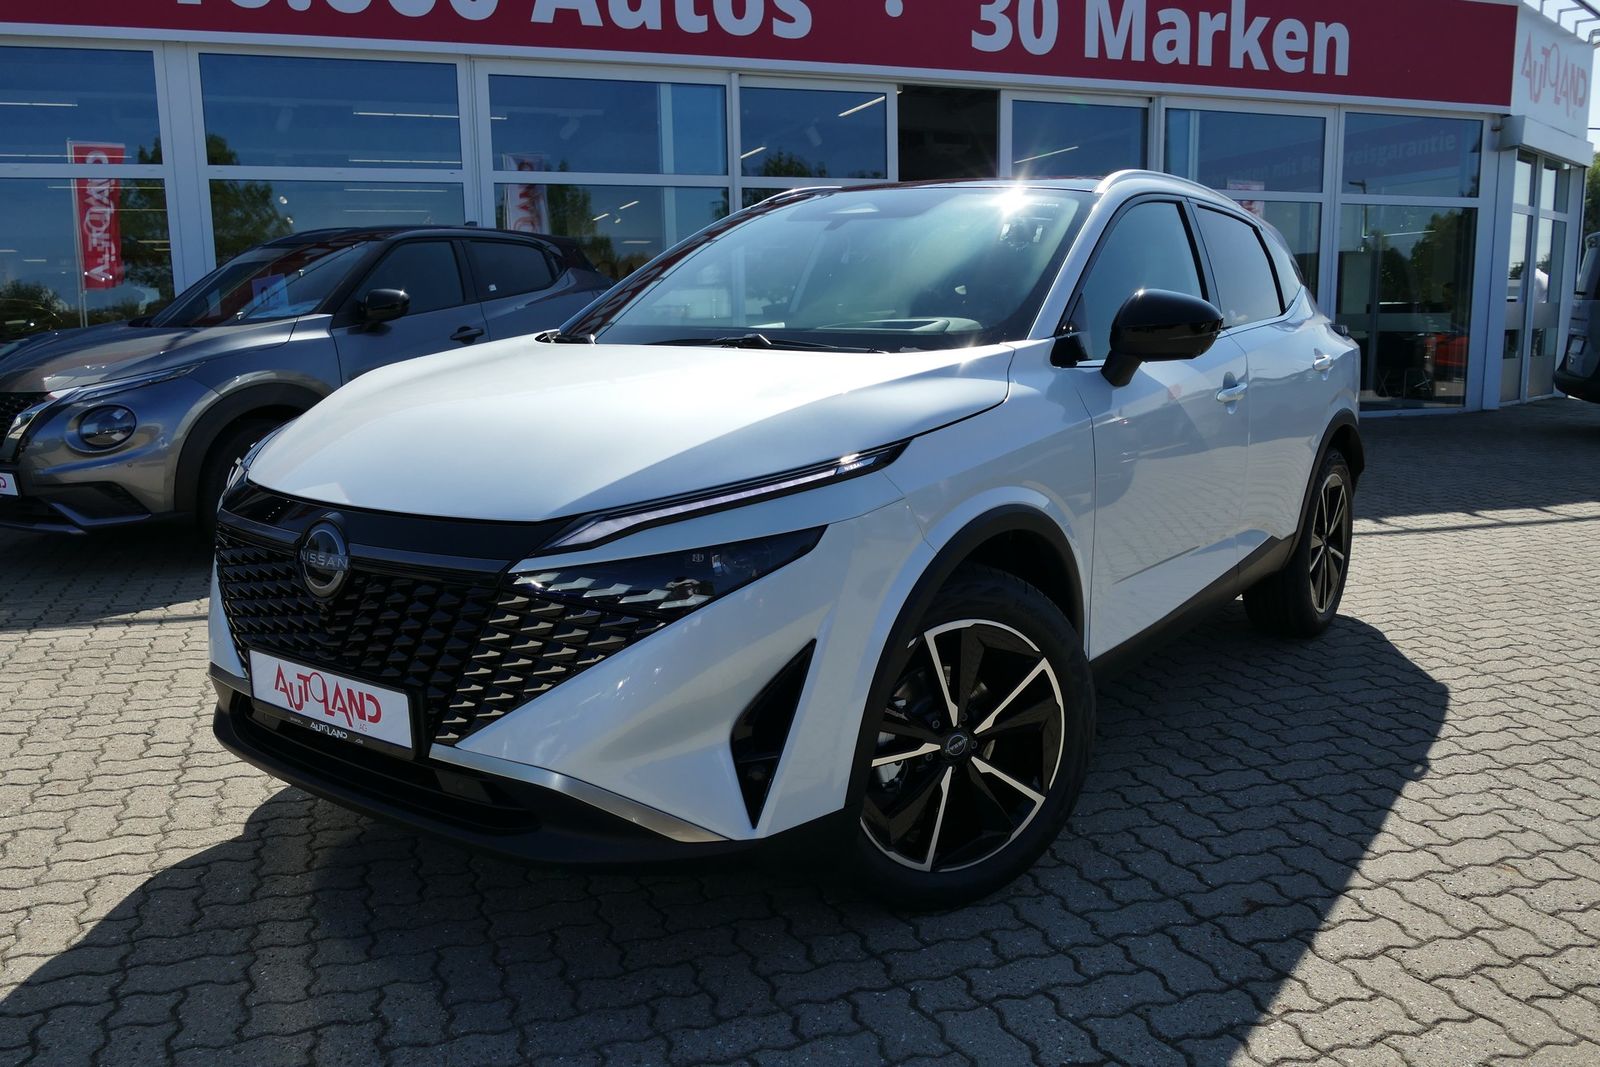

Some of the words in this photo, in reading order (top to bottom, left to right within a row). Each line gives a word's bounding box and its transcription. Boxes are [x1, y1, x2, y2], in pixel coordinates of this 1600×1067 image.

[530, 0, 812, 39] uos
[971, 0, 1059, 55] 30
[1084, 0, 1350, 76] Marken
[1521, 31, 1587, 118] AUTOLAND
[300, 549, 348, 570] NISSAN
[274, 663, 382, 728] AUTOLAND
[310, 721, 348, 740] AUTOLAND
